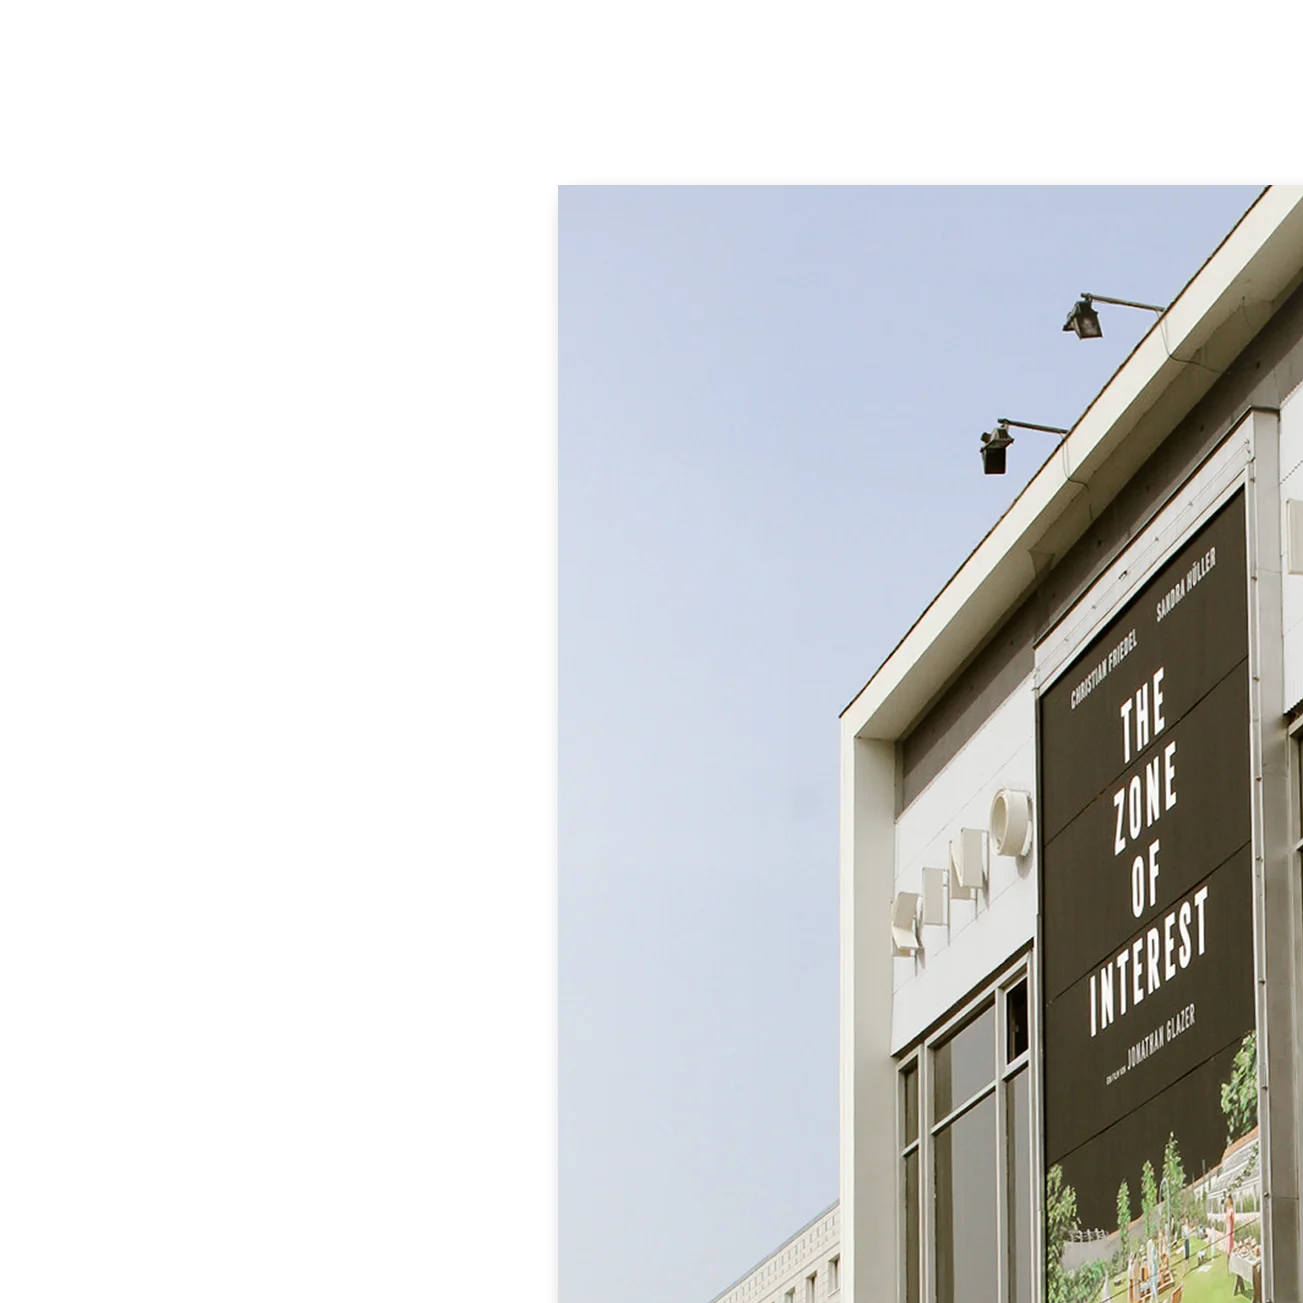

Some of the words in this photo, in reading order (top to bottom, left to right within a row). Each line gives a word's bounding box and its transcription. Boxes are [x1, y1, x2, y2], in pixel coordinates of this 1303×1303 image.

[1071, 660, 1108, 709] CHRISTIAN
[1108, 629, 1138, 672] FRIEDEL
[1156, 578, 1185, 622] SANDRA
[1186, 547, 1217, 592] HÜLLER
[1120, 666, 1165, 764] THE
[1113, 740, 1177, 856] ZONE
[891, 787, 1033, 957] KINO
[1131, 839, 1160, 918] OF
[1090, 885, 1208, 1038] INTEREST
[1127, 1024, 1165, 1071] JONATHAN
[1166, 1003, 1196, 1043] GLAZER
